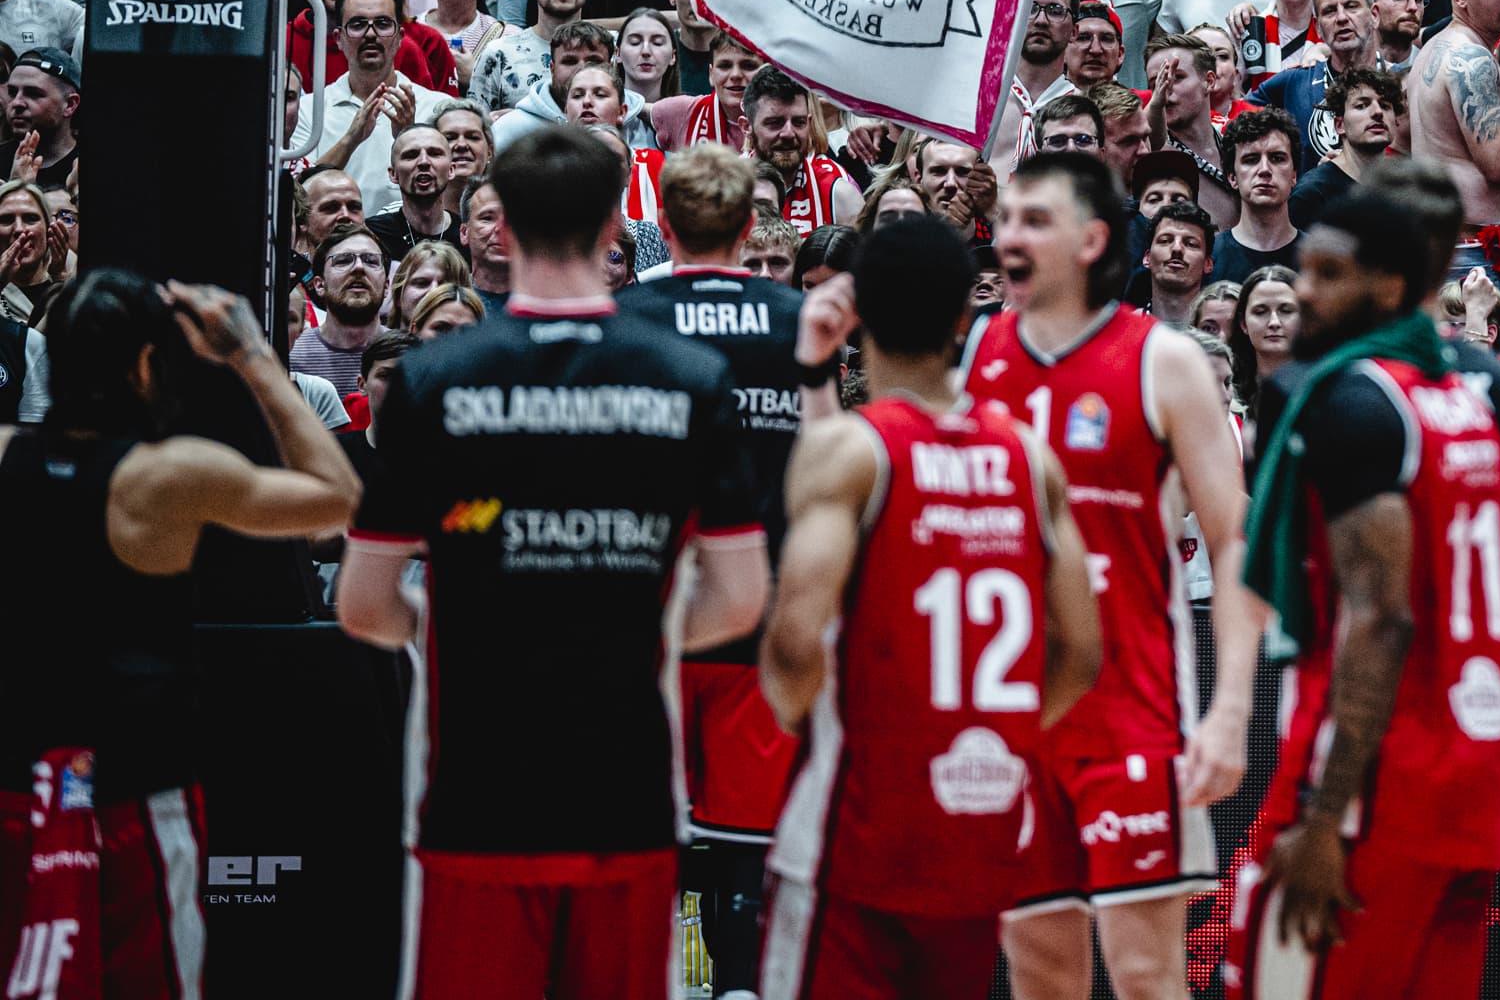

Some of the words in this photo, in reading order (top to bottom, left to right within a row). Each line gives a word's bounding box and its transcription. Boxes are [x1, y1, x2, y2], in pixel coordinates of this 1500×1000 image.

[674, 302, 770, 336] UGRAI
[913, 566, 1041, 713] 12
[234, 894, 277, 904] TEAM
